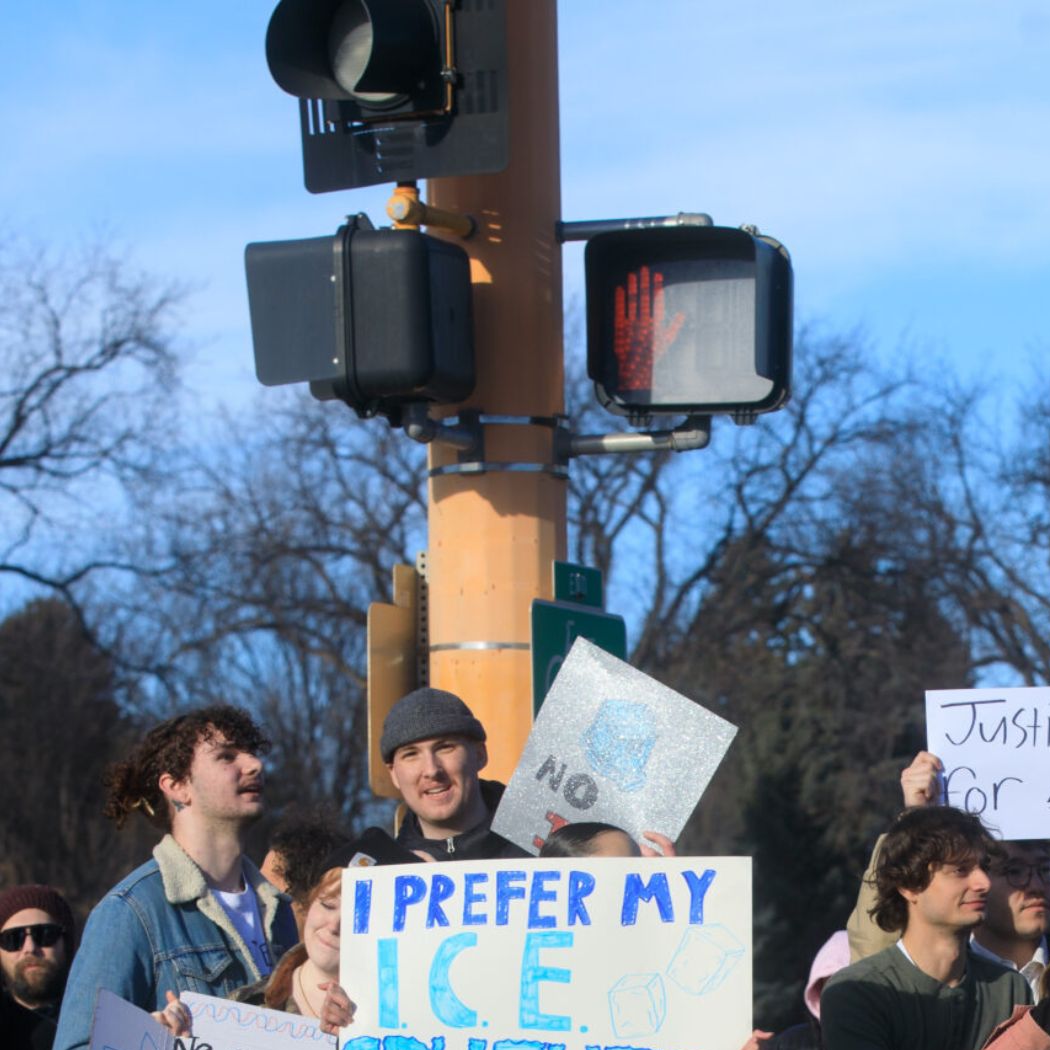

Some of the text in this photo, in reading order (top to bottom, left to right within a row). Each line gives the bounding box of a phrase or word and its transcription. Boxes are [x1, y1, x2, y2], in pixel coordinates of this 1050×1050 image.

[535, 754, 599, 811] NO
[352, 869, 717, 935] I PREFER MY
[377, 930, 590, 1034] I.C.E.
